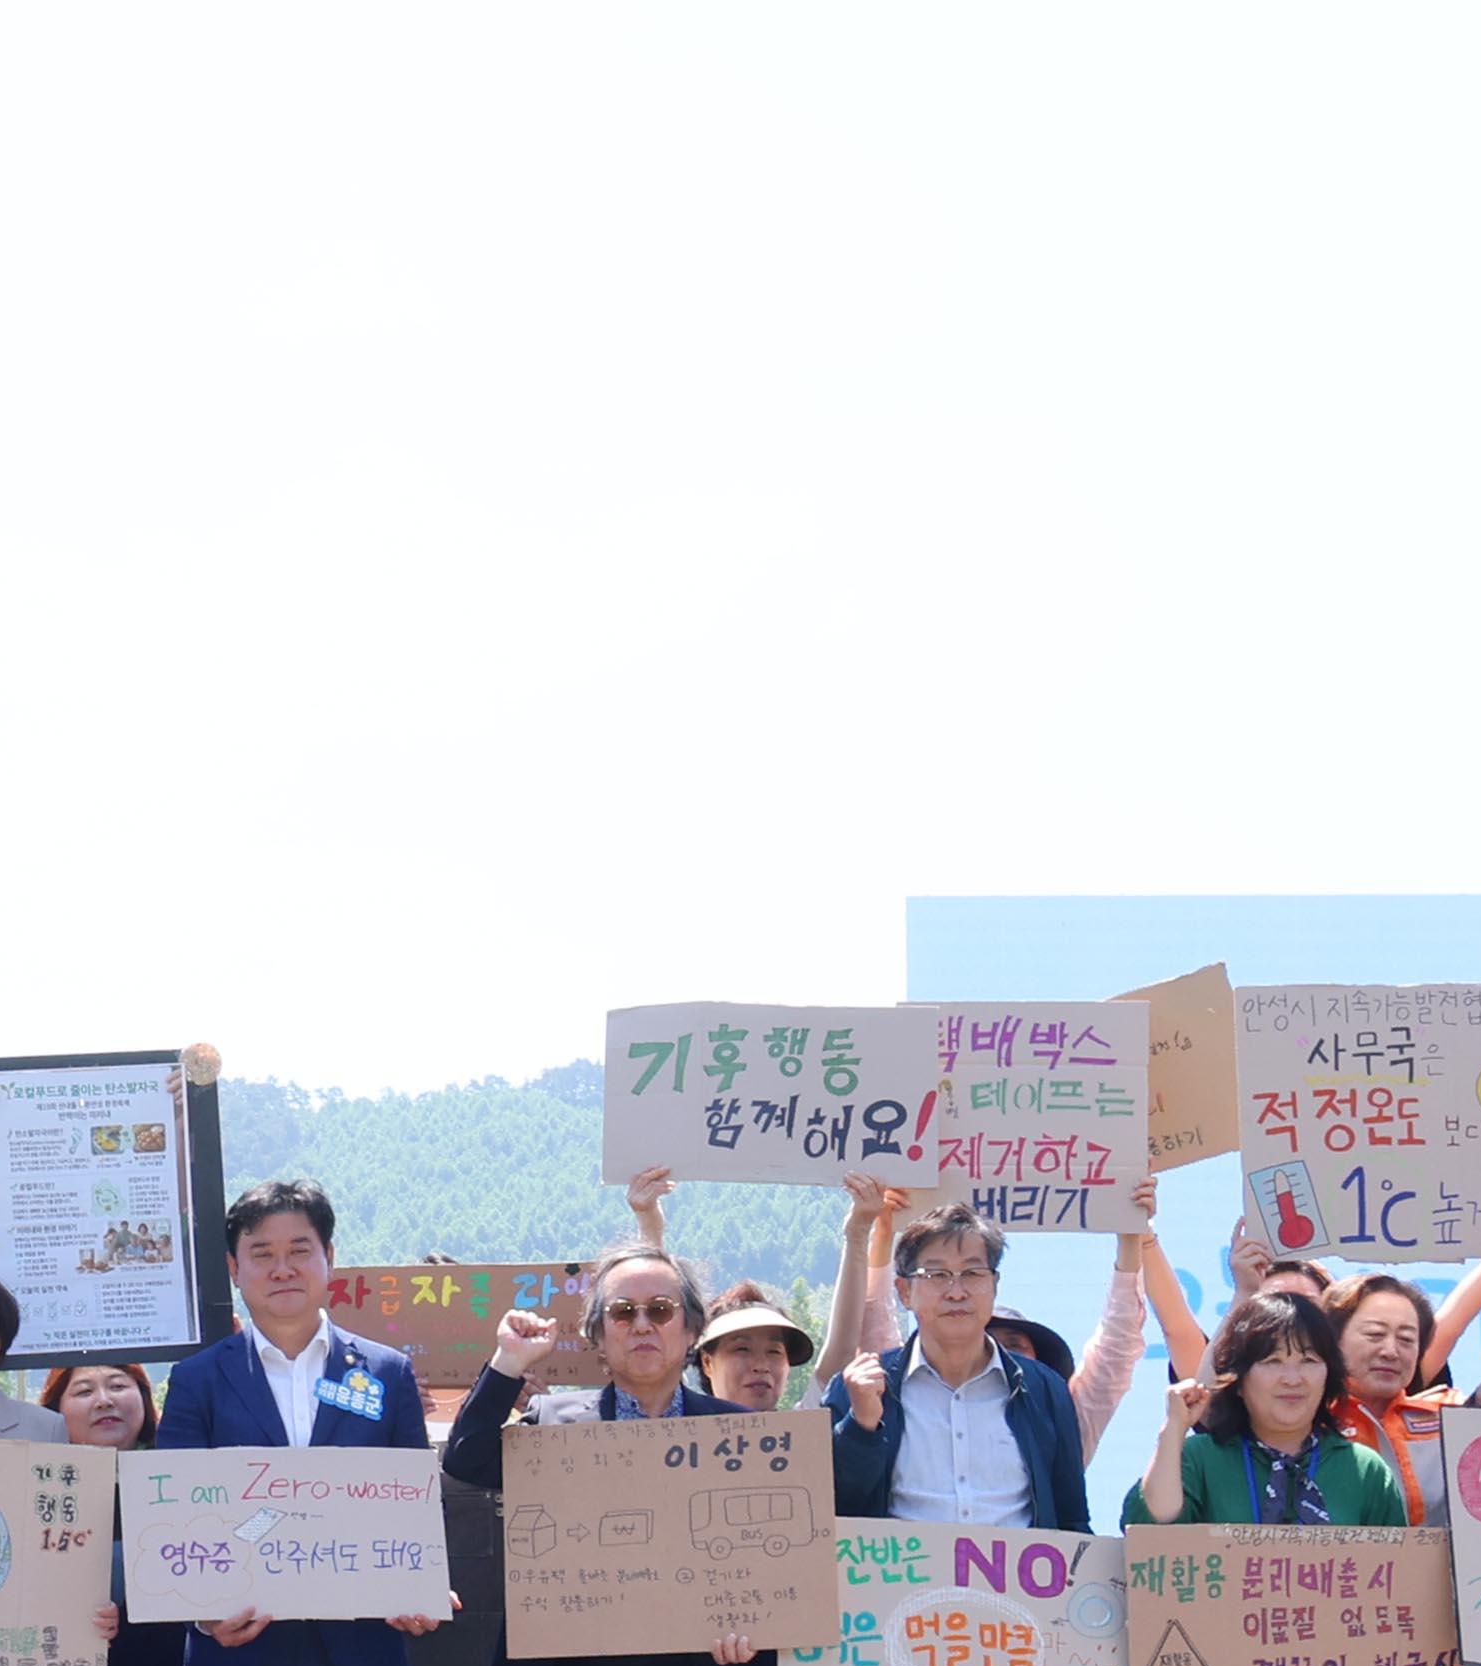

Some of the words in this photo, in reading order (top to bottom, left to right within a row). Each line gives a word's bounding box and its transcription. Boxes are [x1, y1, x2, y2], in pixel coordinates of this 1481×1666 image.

[1242, 992, 1318, 1034] 안성시
[14, 1084, 67, 1099] 로컬푸드로
[71, 1083, 102, 1097] 줄이는
[105, 1081, 158, 1095] 탄소발자국
[970, 1077, 1134, 1116] 테이프는
[704, 1094, 795, 1149] 함께
[803, 1090, 937, 1163] 해요!
[1253, 1086, 1427, 1152] 적정온도
[939, 1132, 1116, 1186] 제거하고
[972, 1186, 1088, 1229] 버리기
[664, 1431, 791, 1473] 이상영
[32, 1463, 78, 1485] 기후
[149, 1474, 178, 1504] I
[192, 1483, 229, 1504] am
[242, 1463, 434, 1504] Zero-waster!
[36, 1495, 78, 1523] 행동
[161, 1541, 236, 1576] 영수증
[837, 1536, 932, 1585] 잔반은
[953, 1536, 1093, 1598] NO!
[1131, 1554, 1226, 1602] 재활용
[1243, 1607, 1316, 1644] 이물질
